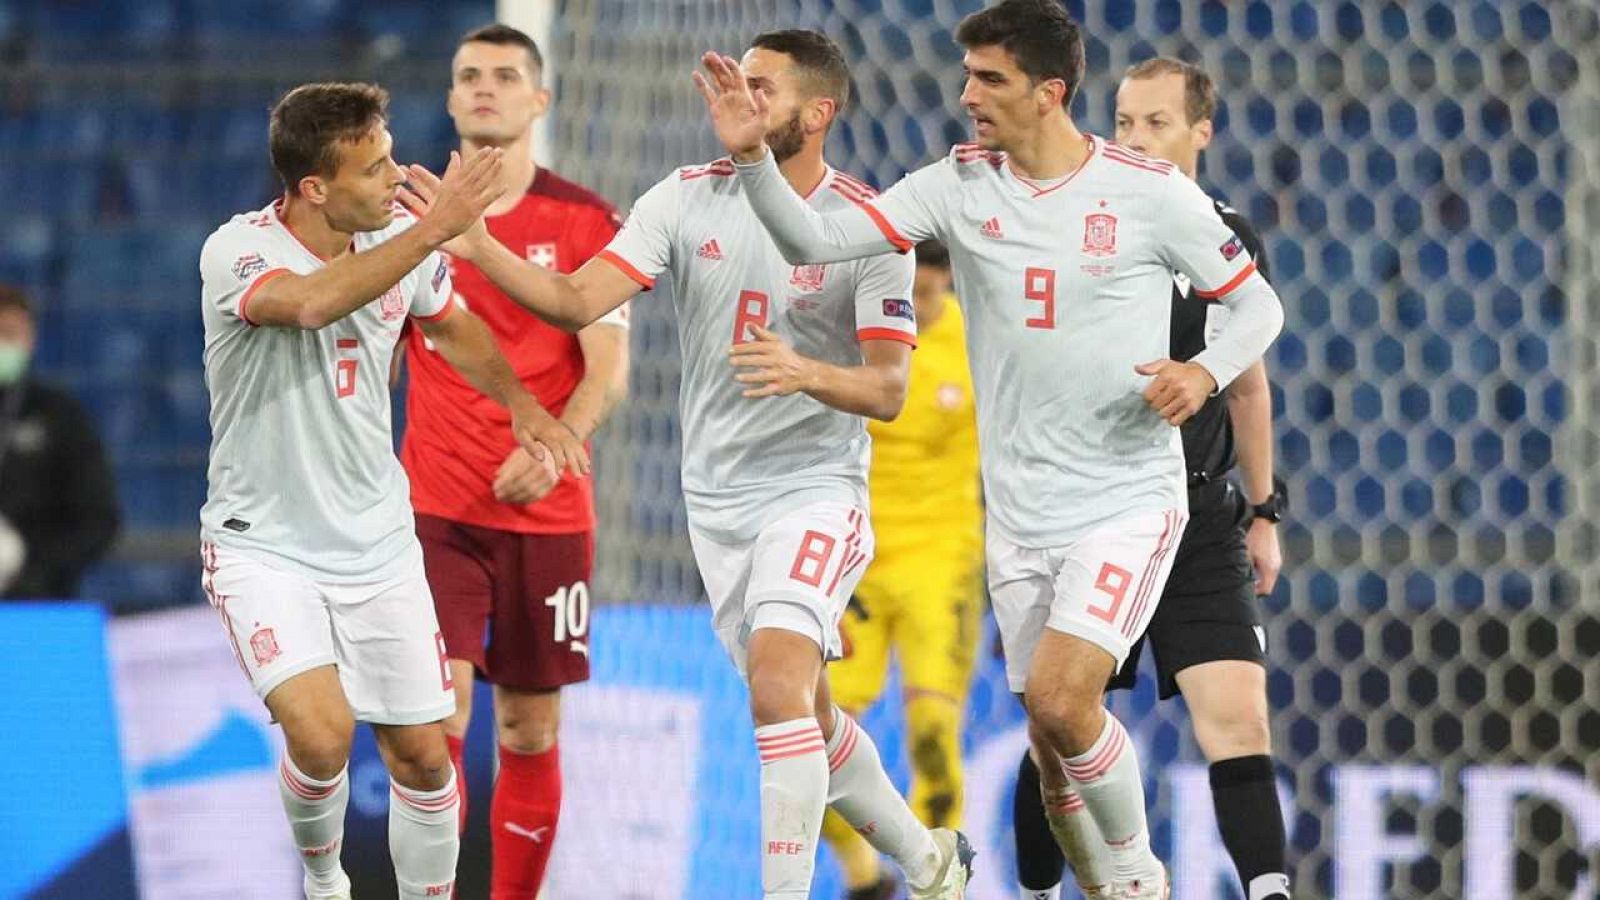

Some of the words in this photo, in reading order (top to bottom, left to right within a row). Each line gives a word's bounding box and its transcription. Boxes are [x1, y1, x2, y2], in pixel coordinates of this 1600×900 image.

[1025, 267, 1055, 329] 9
[790, 530, 835, 588] 8
[545, 581, 589, 642] 10
[1086, 562, 1133, 624] 9
